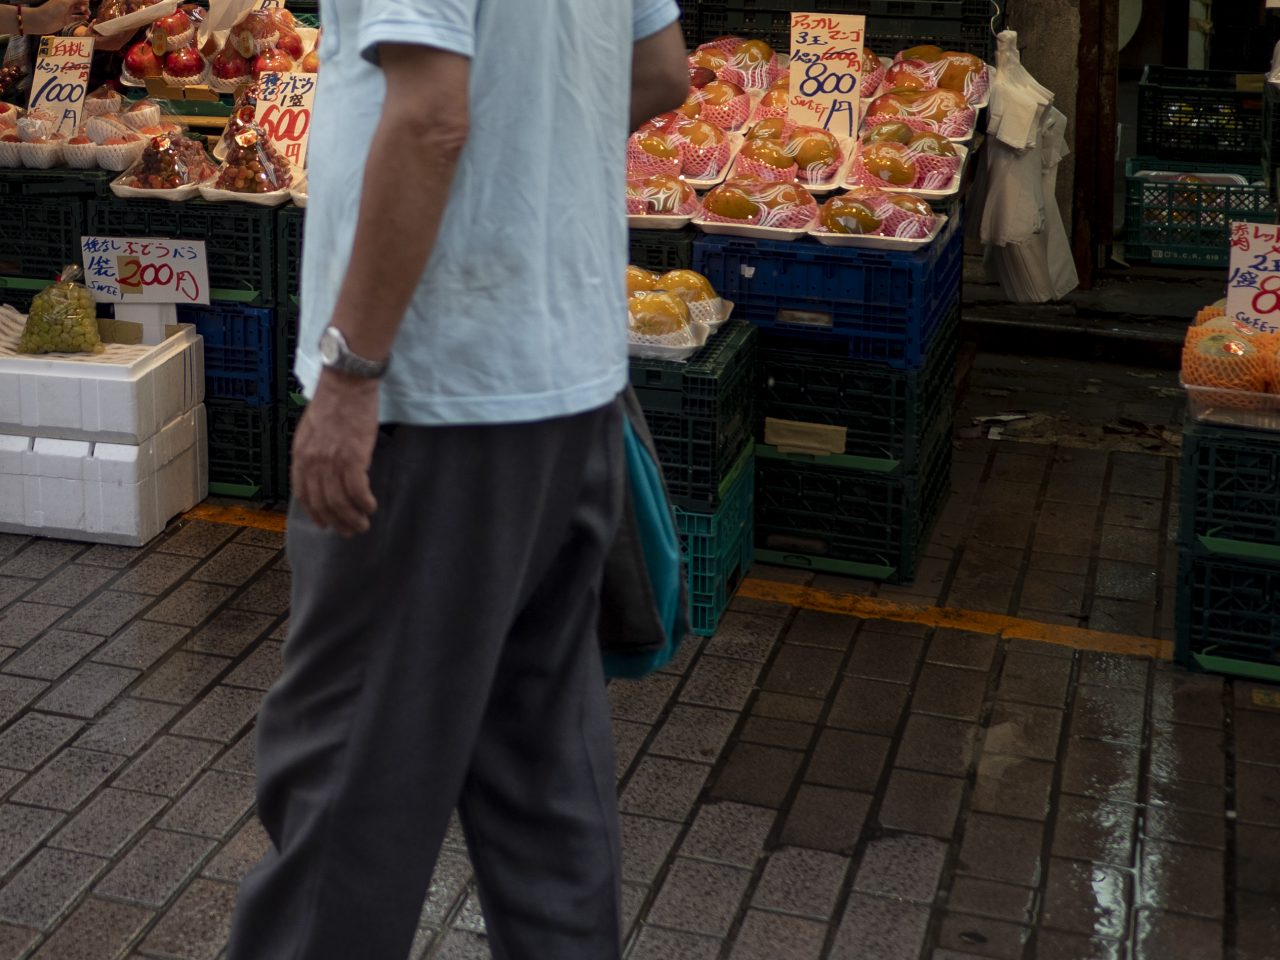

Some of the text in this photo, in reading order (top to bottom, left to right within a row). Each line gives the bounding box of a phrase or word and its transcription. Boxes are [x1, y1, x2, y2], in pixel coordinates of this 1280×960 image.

[30, 75, 85, 108] 1000
[800, 62, 857, 97] 800
[258, 104, 311, 142] 600
